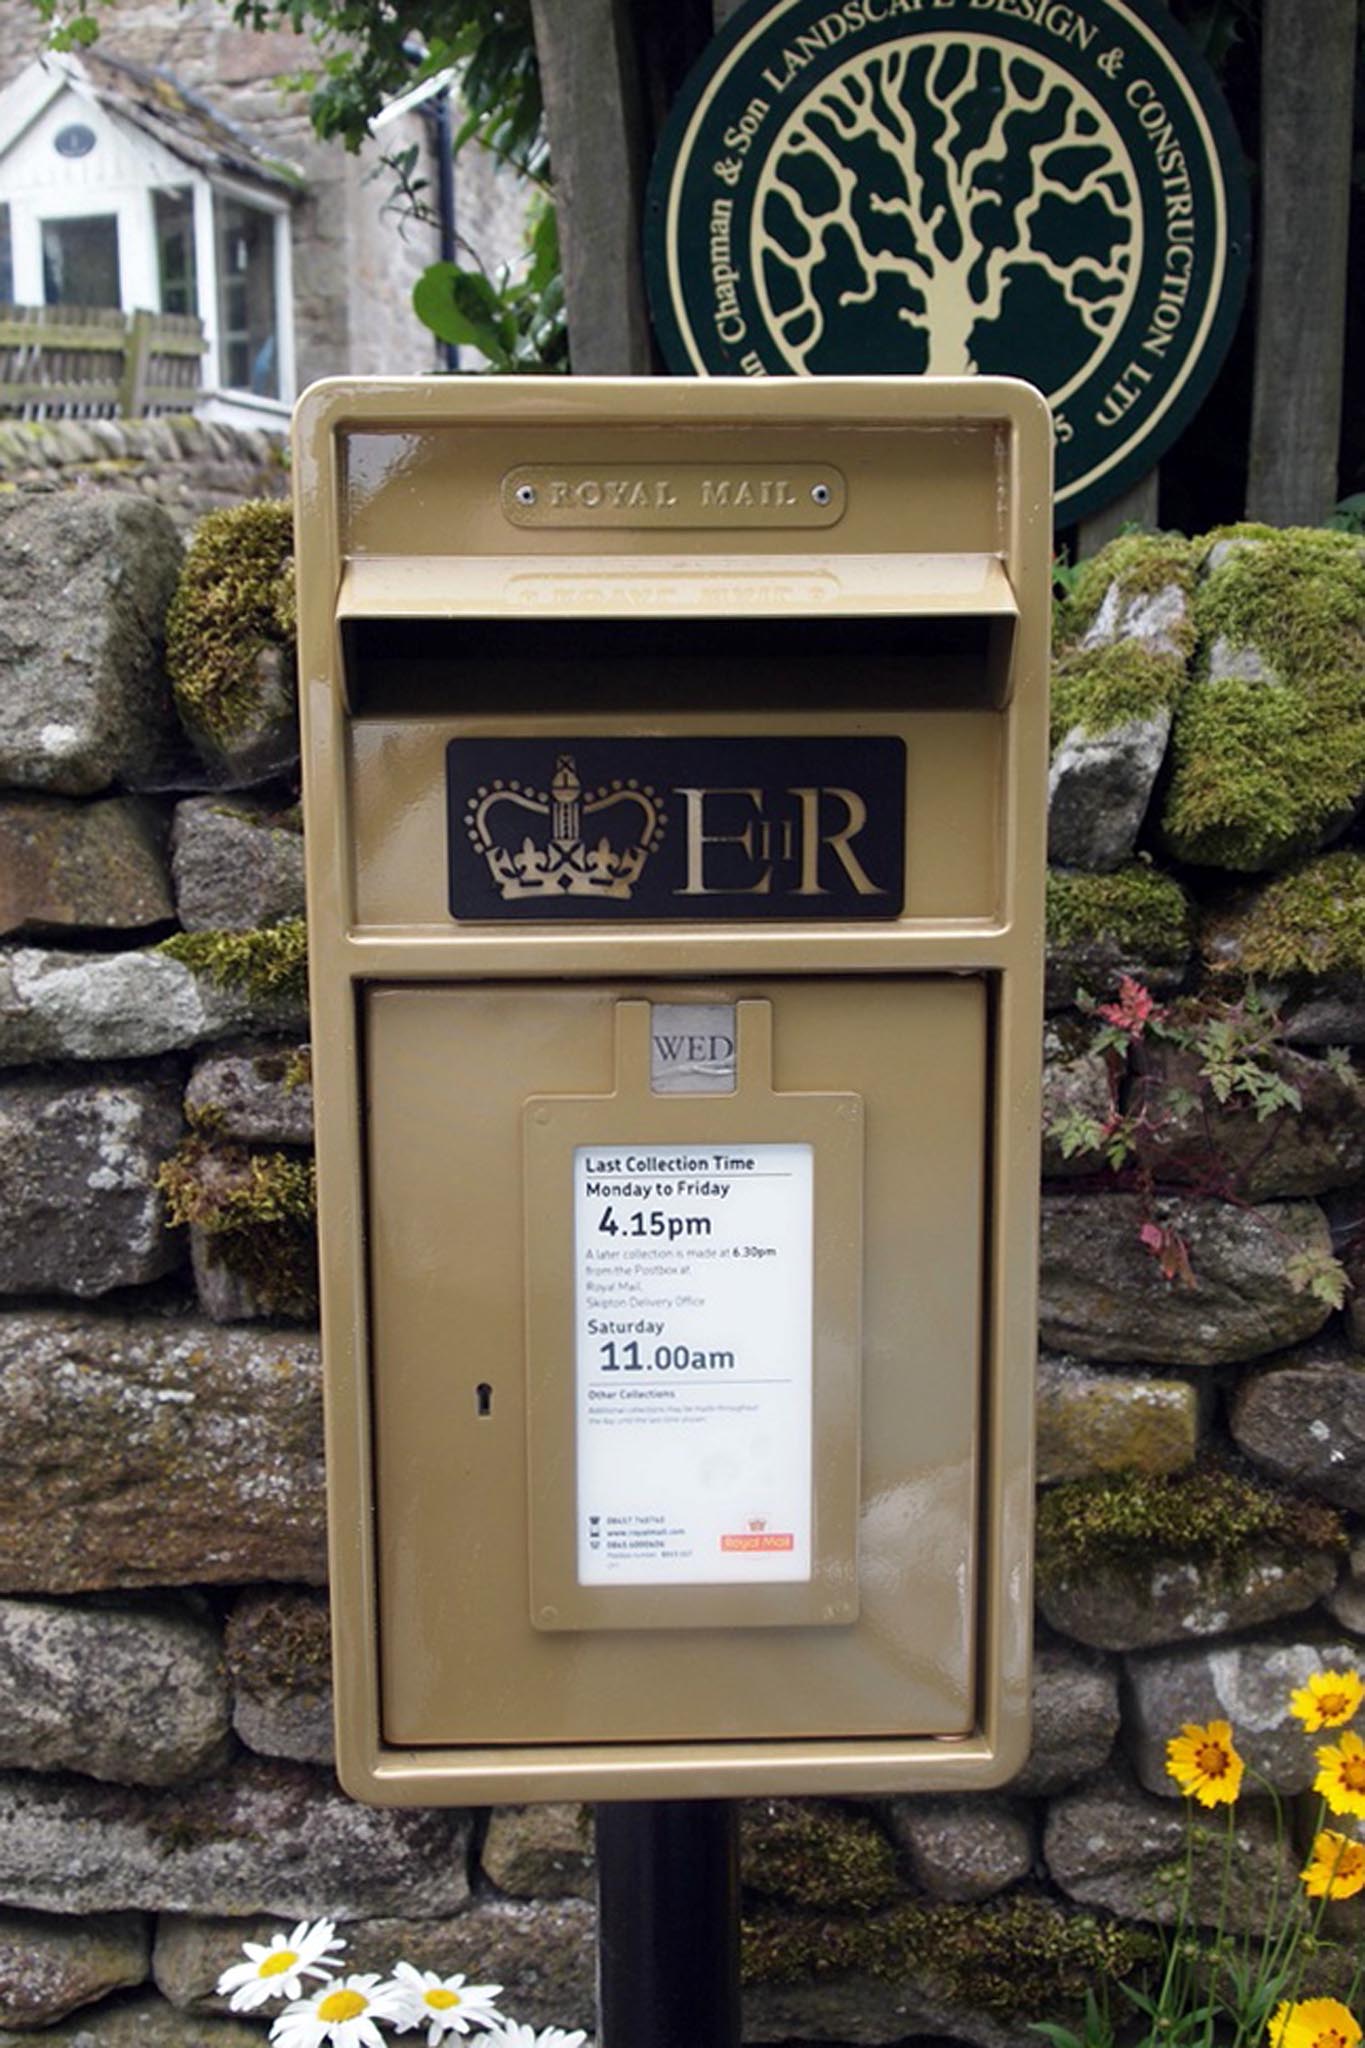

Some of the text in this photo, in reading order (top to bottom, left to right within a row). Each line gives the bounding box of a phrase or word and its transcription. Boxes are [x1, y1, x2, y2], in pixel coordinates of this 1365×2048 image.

[1096, 47, 1125, 80] &
[723, 97, 771, 155] Son
[712, 155, 744, 185] &
[1125, 78, 1195, 358] CONSTRUCTION
[709, 198, 747, 344] Chapman
[1095, 361, 1153, 427] LTD
[549, 479, 797, 507] ROYAL MAIL
[653, 1035, 734, 1062] WED
[585, 1155, 755, 1173] Last Collection Time
[585, 1180, 731, 1200] Monday to Friday
[598, 1206, 712, 1242] 4.15pm
[623, 1248, 673, 1259] collection
[587, 1318, 665, 1336] Saturday
[600, 1339, 735, 1371] 11.00am
[619, 1389, 676, 1399] Collections
[724, 1535, 790, 1550] Royal Mail
